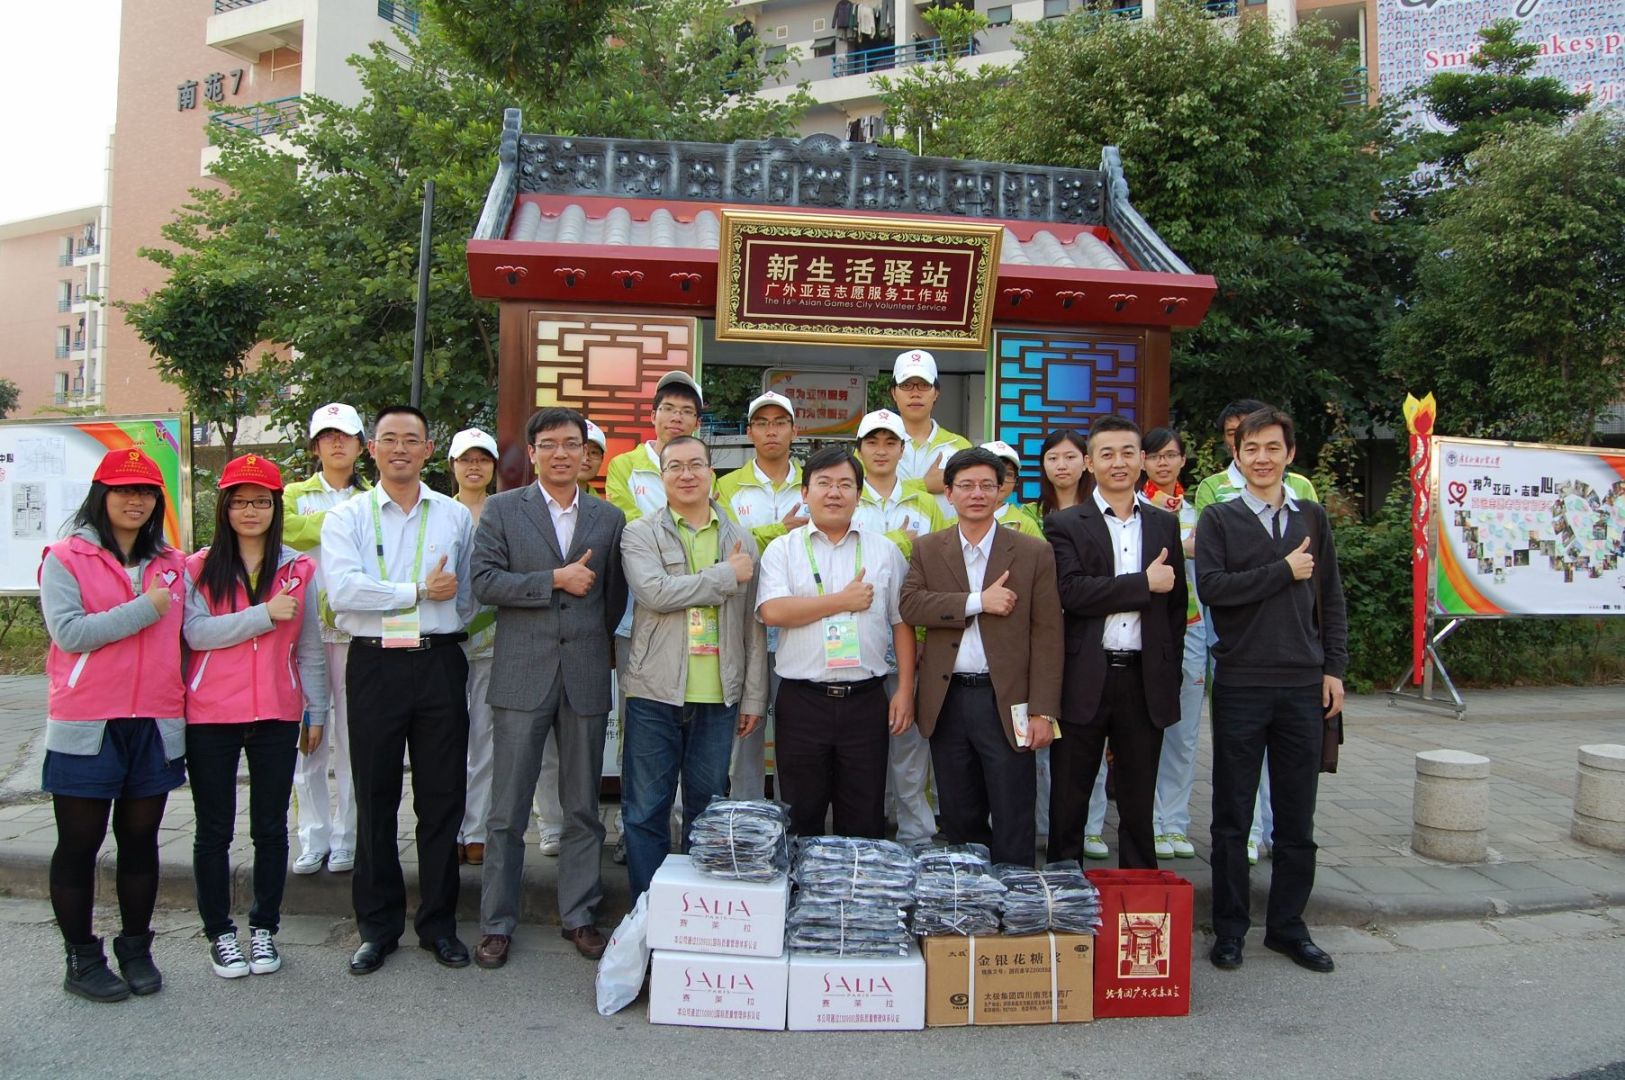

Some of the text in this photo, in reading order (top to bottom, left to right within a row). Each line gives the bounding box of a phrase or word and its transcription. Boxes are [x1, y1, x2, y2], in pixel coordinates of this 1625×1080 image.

[766, 253, 952, 288] 新生活驿站
[764, 283, 950, 303] 广外亚运志愿服务工作站
[765, 297, 779, 305] The
[799, 299, 821, 307] Asian
[825, 300, 854, 308] Games
[856, 301, 873, 310] City
[875, 302, 915, 311] Volunteer
[917, 303, 947, 312] Service
[682, 891, 751, 917] SALIA
[684, 967, 754, 991] SALIA
[823, 971, 893, 993] SALIA
